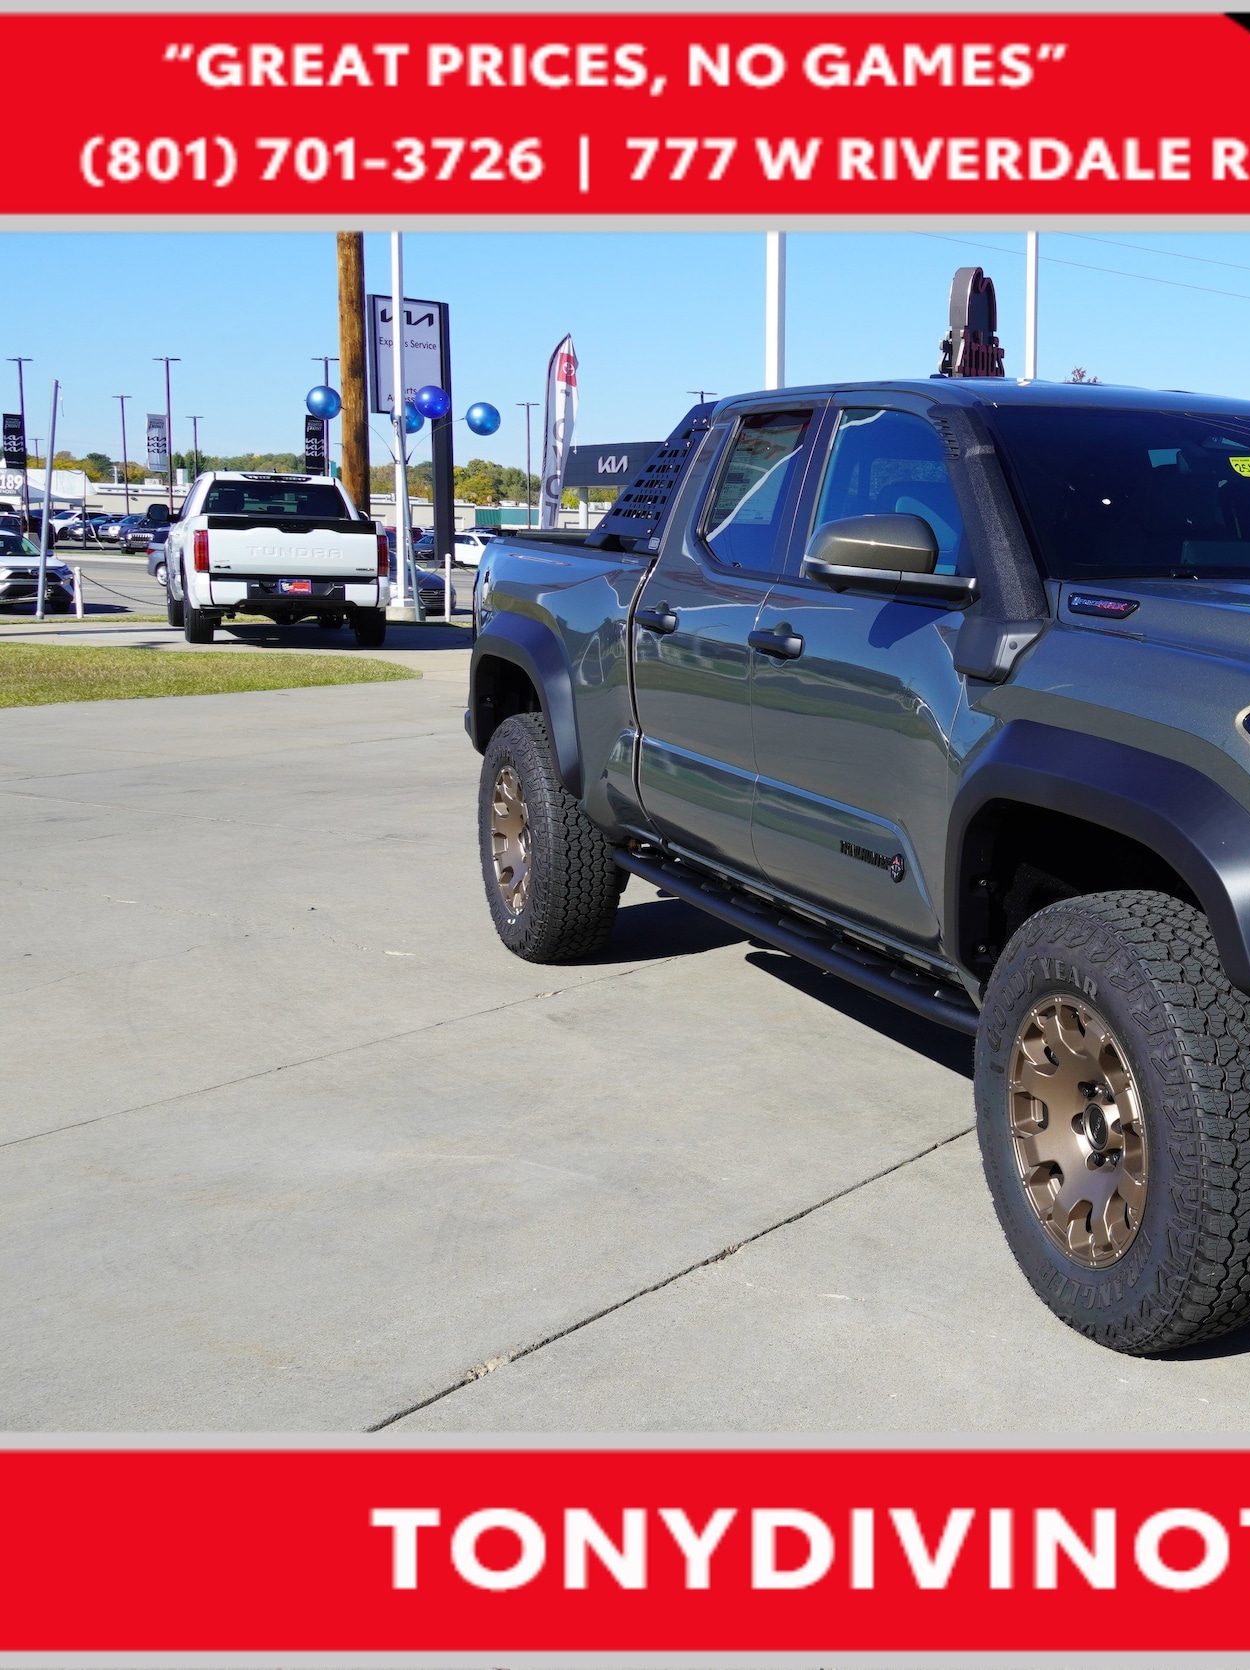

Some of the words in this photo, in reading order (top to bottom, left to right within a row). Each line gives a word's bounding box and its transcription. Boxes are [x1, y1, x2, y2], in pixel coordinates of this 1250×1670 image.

[379, 337, 409, 348] Exps
[410, 340, 437, 350] Service
[246, 545, 344, 559] TUNDRA
